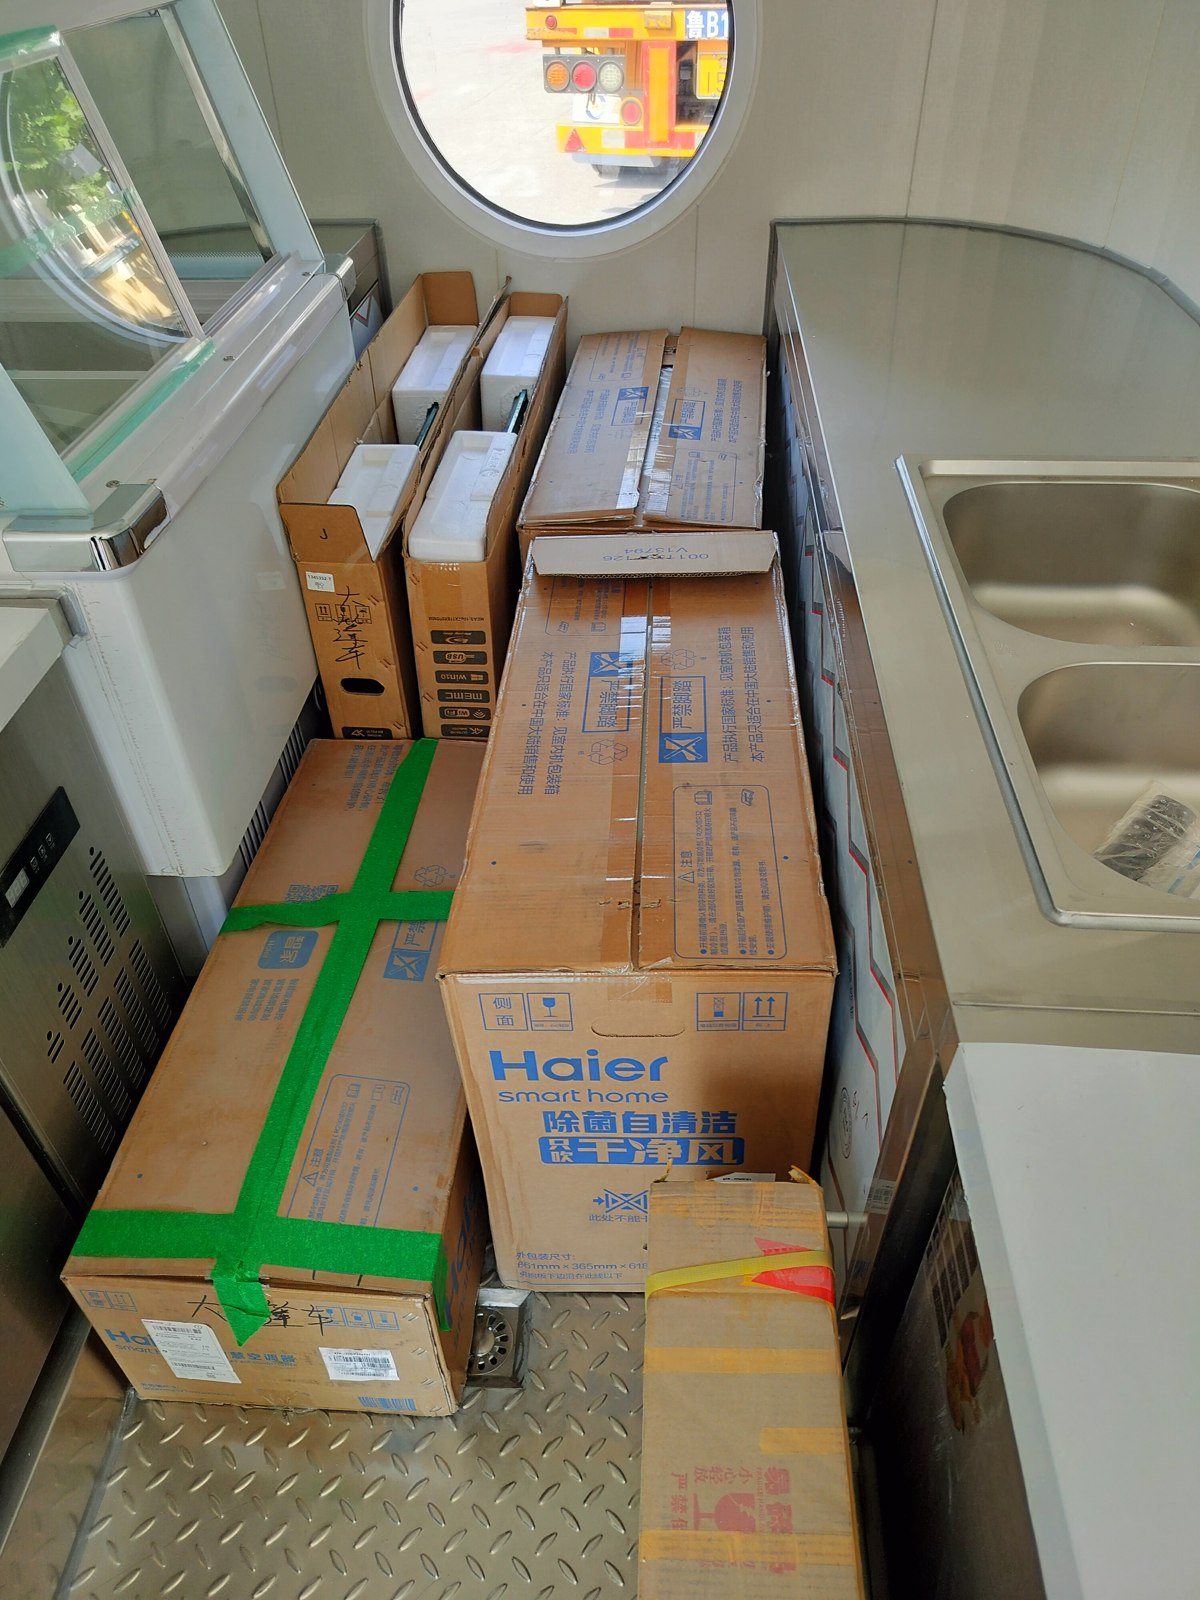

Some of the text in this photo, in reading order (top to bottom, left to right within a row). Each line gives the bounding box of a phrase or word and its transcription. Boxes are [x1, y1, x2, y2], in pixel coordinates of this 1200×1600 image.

[446, 653, 464, 661] USB
[597, 679, 620, 729] 严禁脚踏
[671, 680, 692, 730] 严禁脚踏
[680, 850, 693, 868] 注意
[489, 1049, 669, 1082] Haier
[498, 1088, 669, 1104] smart home
[543, 1110, 738, 1135] 除菌自清洁
[694, 1466, 754, 1485] 小心轻放
